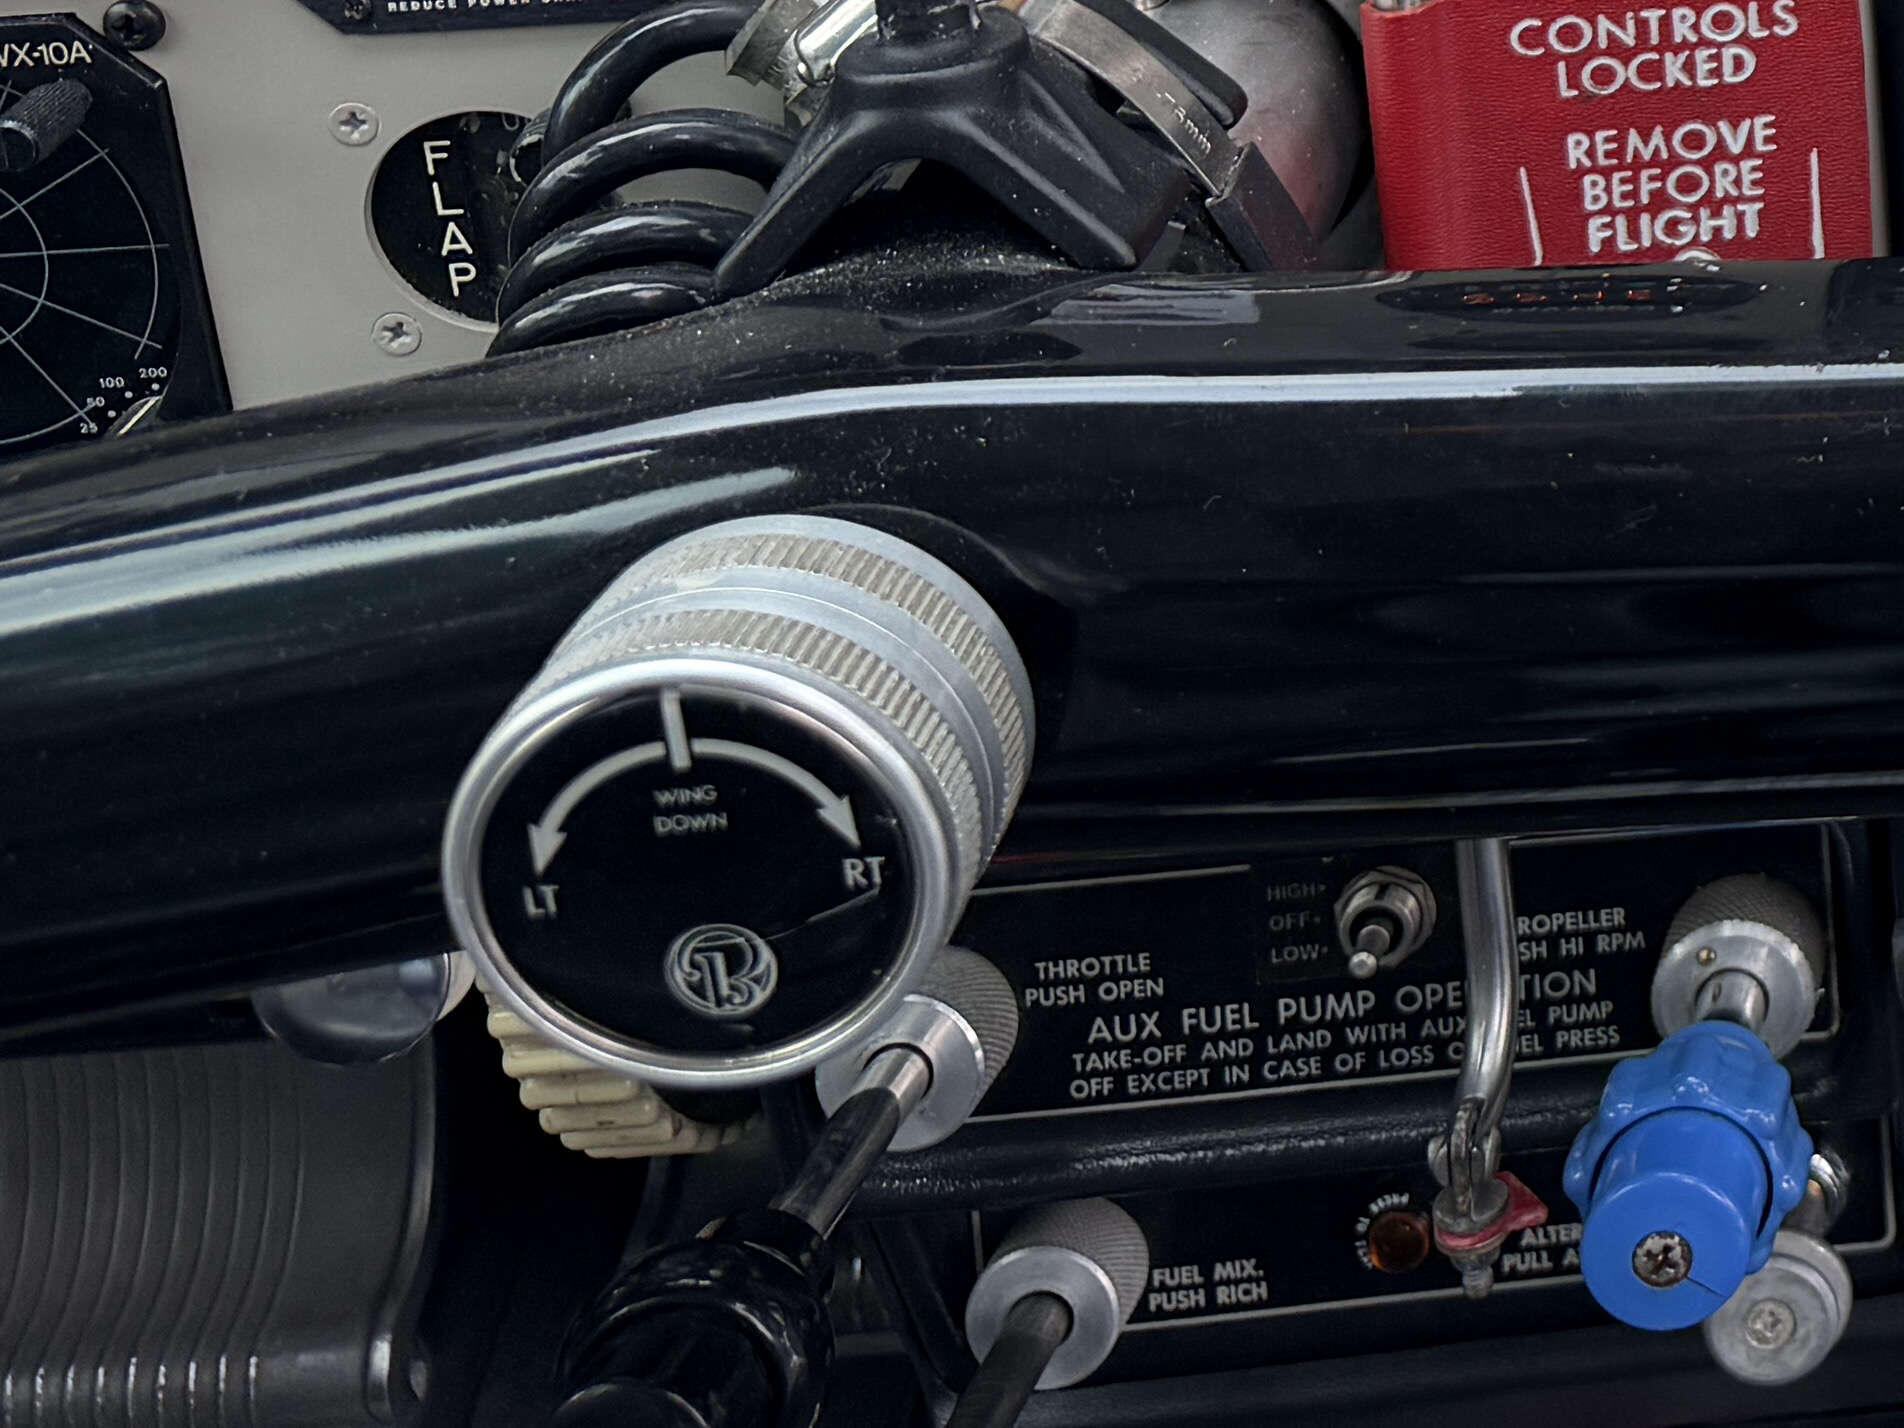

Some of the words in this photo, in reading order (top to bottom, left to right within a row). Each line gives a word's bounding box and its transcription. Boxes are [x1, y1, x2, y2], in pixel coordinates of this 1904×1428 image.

[1557, 45, 1757, 99] LOCKED
[1566, 114, 1777, 170] REMOVE
[1582, 158, 1765, 212] BEFORE
[422, 141, 477, 297] FLAP
[1587, 202, 1765, 254] FLIGHT
[653, 784, 718, 807] WING
[653, 812, 728, 837] DOWN
[842, 857, 885, 889] RT
[522, 885, 559, 920] LT
[1034, 952, 1152, 982] THROTTLE
[1025, 982, 1086, 1008] PUSH
[1098, 976, 1164, 1002] OPEN
[1088, 1009, 1163, 1045] AUX
[1181, 1002, 1256, 1036] FUEL
[1277, 990, 1377, 1024] PUMP
[1152, 1263, 1204, 1288] FUEL
[1213, 1257, 1265, 1283] MIX.
[1149, 1287, 1205, 1312] PUSH
[1216, 1278, 1269, 1305] RICH
